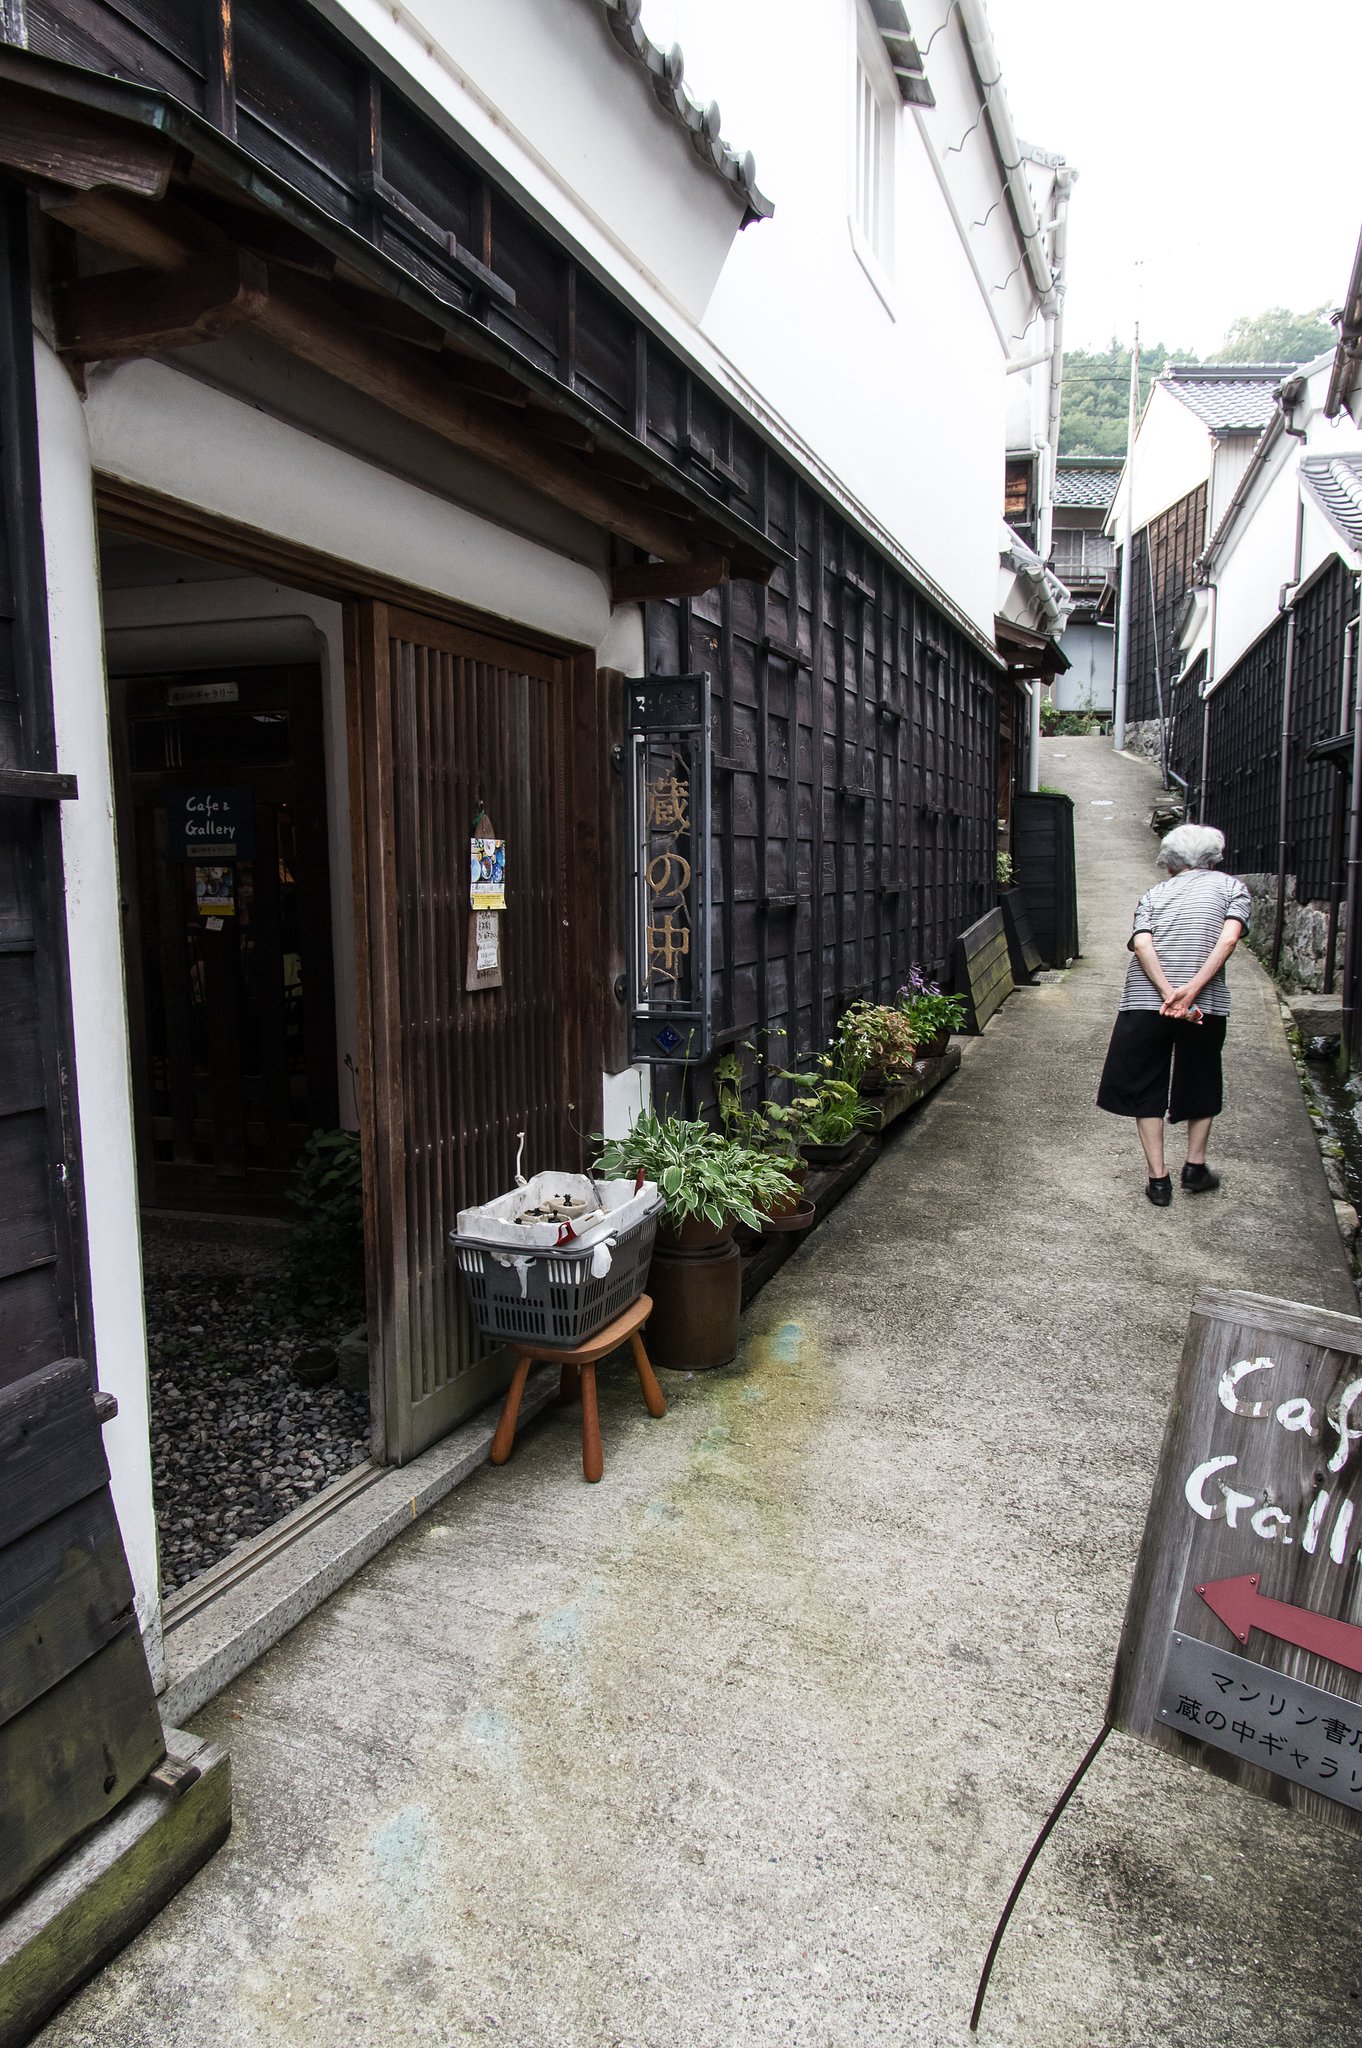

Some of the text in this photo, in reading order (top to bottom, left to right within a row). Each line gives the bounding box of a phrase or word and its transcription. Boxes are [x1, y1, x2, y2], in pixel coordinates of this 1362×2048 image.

[185, 819, 236, 840] Gallery
[644, 777, 691, 969] 蔵の中
[1184, 1454, 1362, 1565] Gall
